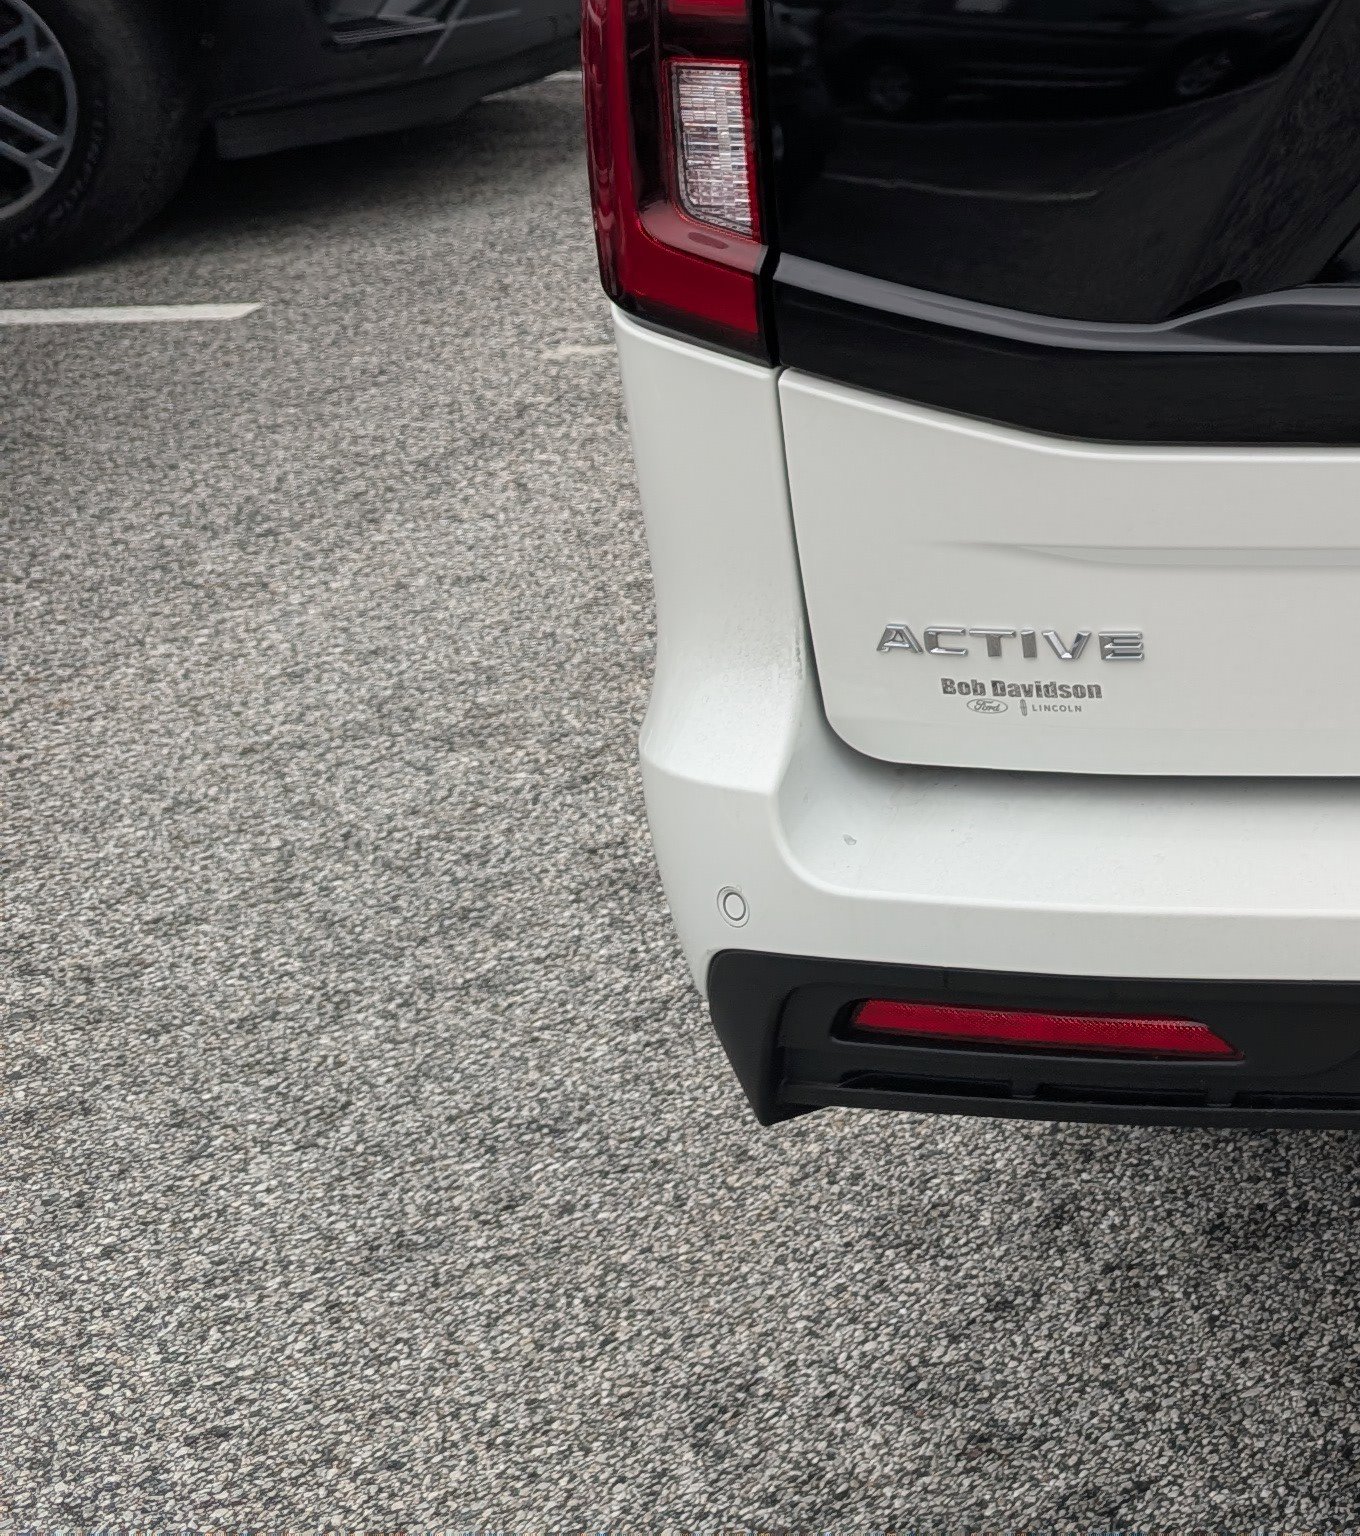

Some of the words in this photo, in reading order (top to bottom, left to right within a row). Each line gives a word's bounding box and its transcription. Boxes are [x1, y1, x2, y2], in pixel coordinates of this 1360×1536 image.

[876, 623, 1144, 661] ACTIVE
[941, 678, 986, 696] Bob
[991, 679, 1102, 699] Davidson
[1032, 704, 1082, 713] LINCOLN
